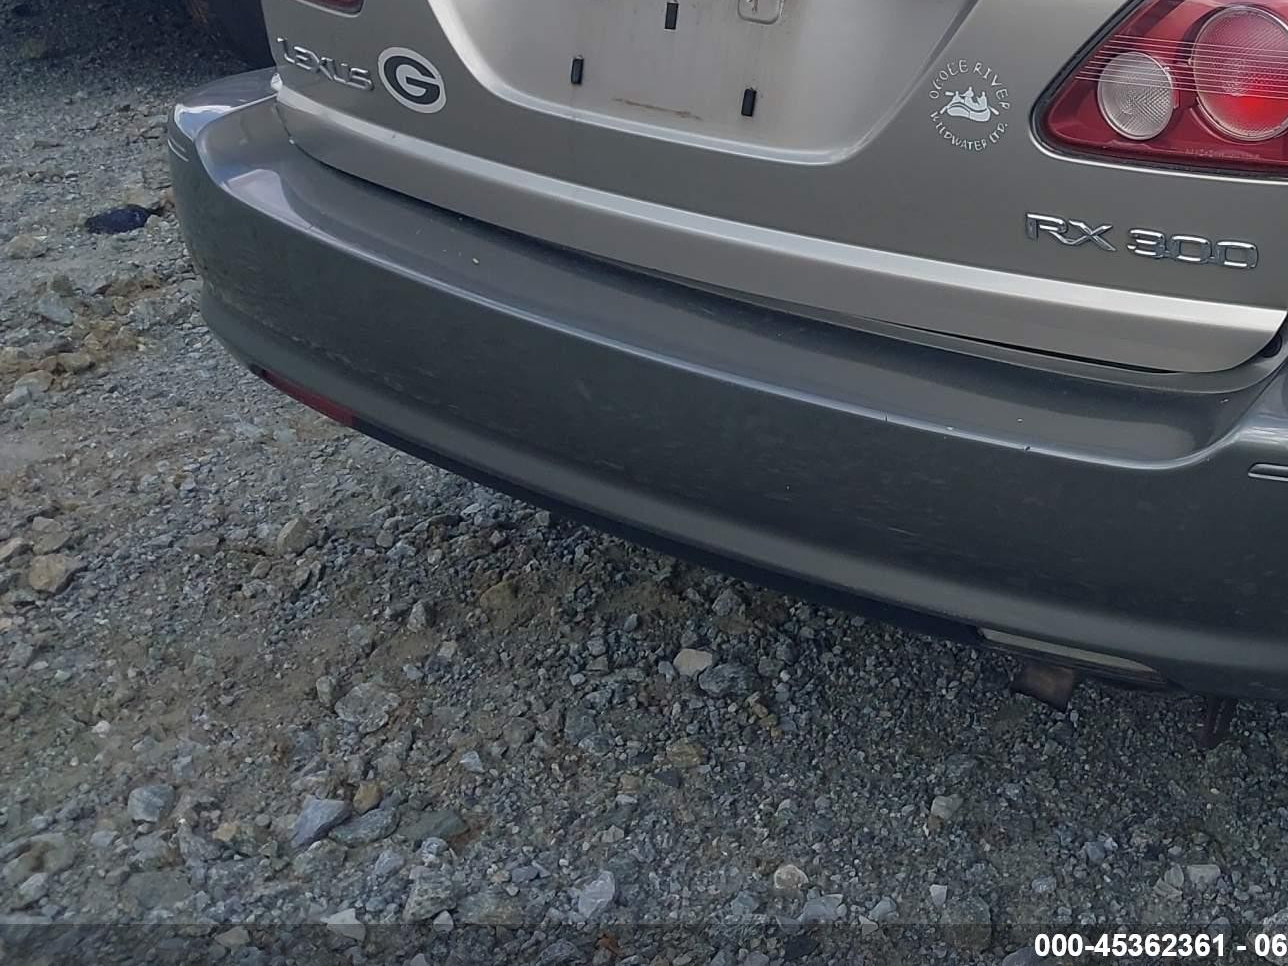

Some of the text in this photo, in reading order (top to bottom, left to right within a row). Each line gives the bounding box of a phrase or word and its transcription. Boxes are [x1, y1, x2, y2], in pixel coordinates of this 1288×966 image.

[276, 36, 375, 92] LEXUS
[381, 52, 443, 108] G
[1025, 212, 1259, 269] RX 300
